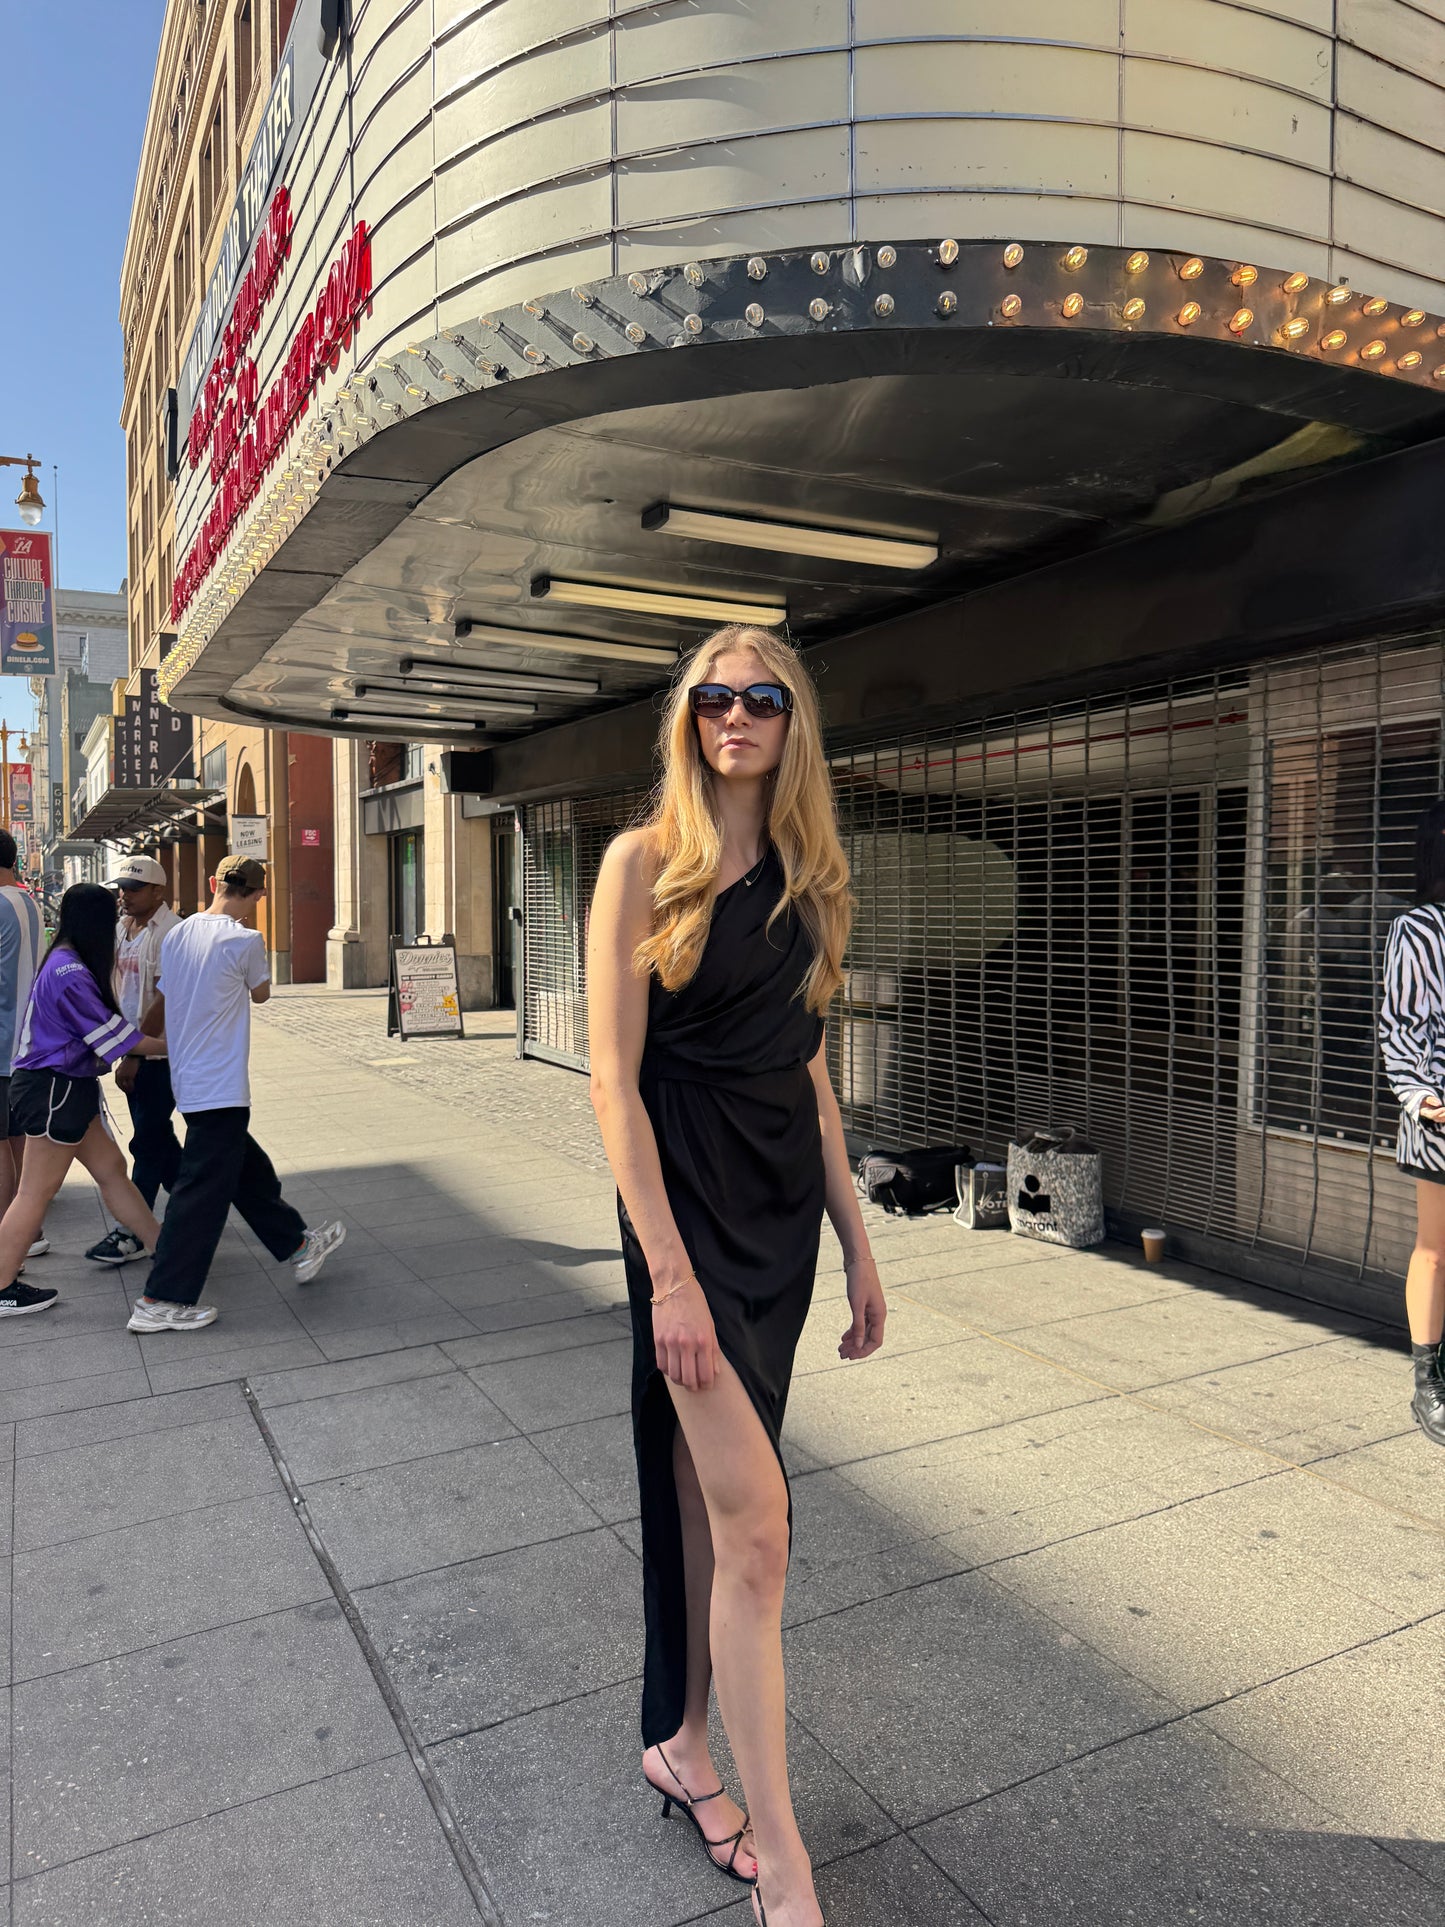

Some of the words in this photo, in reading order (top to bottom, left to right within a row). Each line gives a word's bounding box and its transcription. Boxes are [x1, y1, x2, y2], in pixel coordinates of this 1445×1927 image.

[213, 207, 241, 333] DOLLAR
[242, 63, 292, 243] THEATER
[4, 557, 43, 580] CULTURE
[5, 581, 45, 600] THROUGH
[7, 600, 45, 623] CUISINE
[6, 655, 49, 664] DINELA.COM
[150, 674, 160, 787] CENTRAL
[132, 700, 141, 785] MARKET
[236, 838, 262, 848] LEASING
[120, 866, 143, 874] niche
[1016, 1218, 1058, 1232] marant
